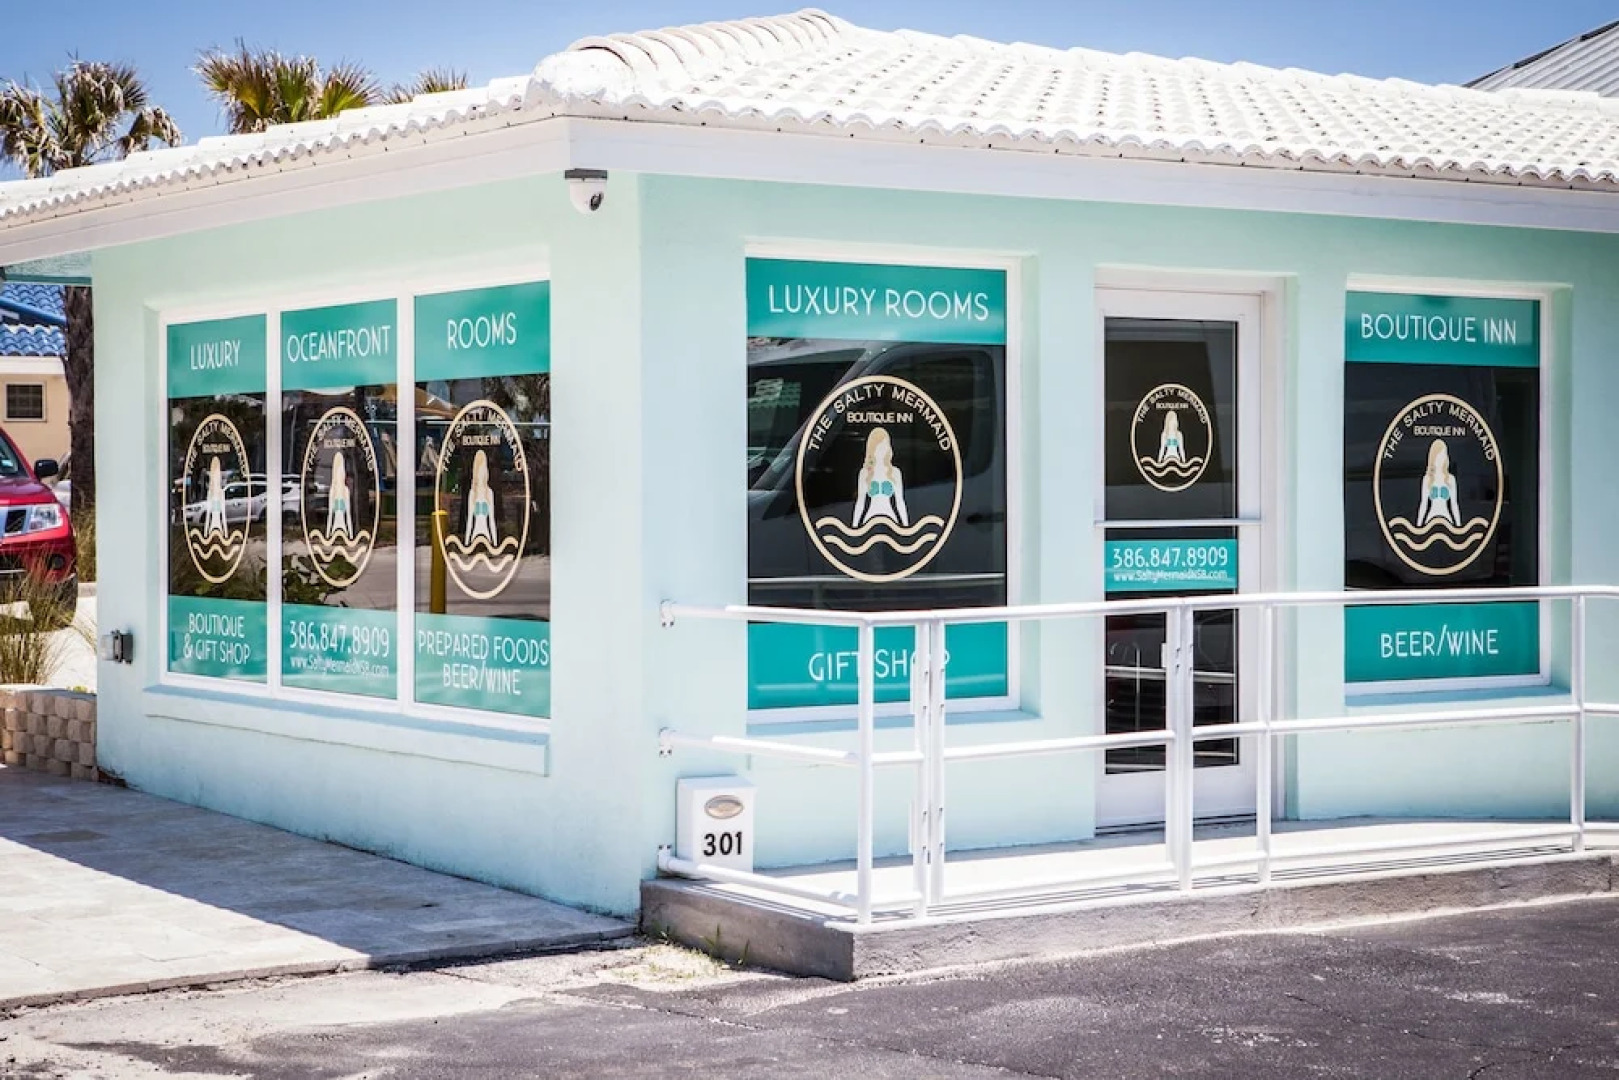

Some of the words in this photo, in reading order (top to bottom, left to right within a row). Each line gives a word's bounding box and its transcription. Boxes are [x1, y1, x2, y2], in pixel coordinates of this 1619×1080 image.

[768, 284, 876, 316] LUXURY
[885, 288, 989, 322] ROOMS
[287, 324, 391, 363] OCEANFRONT
[447, 311, 517, 349] ROOMS
[1361, 313, 1476, 343] BOUTIQUE
[1483, 318, 1516, 345] INN
[190, 339, 241, 370] LUXURY
[808, 414, 833, 450] THE
[833, 383, 884, 414] SALTY
[891, 386, 951, 451] MERMAID
[846, 412, 895, 424] BOUTIQUE
[896, 412, 913, 424] INN
[1383, 427, 1404, 459] THE
[1403, 401, 1444, 427] SALTY
[1448, 404, 1496, 461] MERMAID
[1414, 425, 1451, 437] BOUTIQUE
[1452, 425, 1466, 437] INN
[1113, 546, 1228, 568] 386.847.8909
[188, 612, 245, 639] BOUTIQUE
[289, 620, 390, 658] 386.847.8909
[1380, 624, 1499, 659] BEER/WINE
[183, 632, 193, 659] &
[195, 639, 217, 661] GIFT
[219, 640, 250, 665] SHOP
[418, 629, 490, 660] PREPARED
[493, 635, 549, 666] FOODS
[875, 648, 950, 679] SH
[443, 660, 522, 696] BEER/WINE
[703, 831, 742, 857] 301
